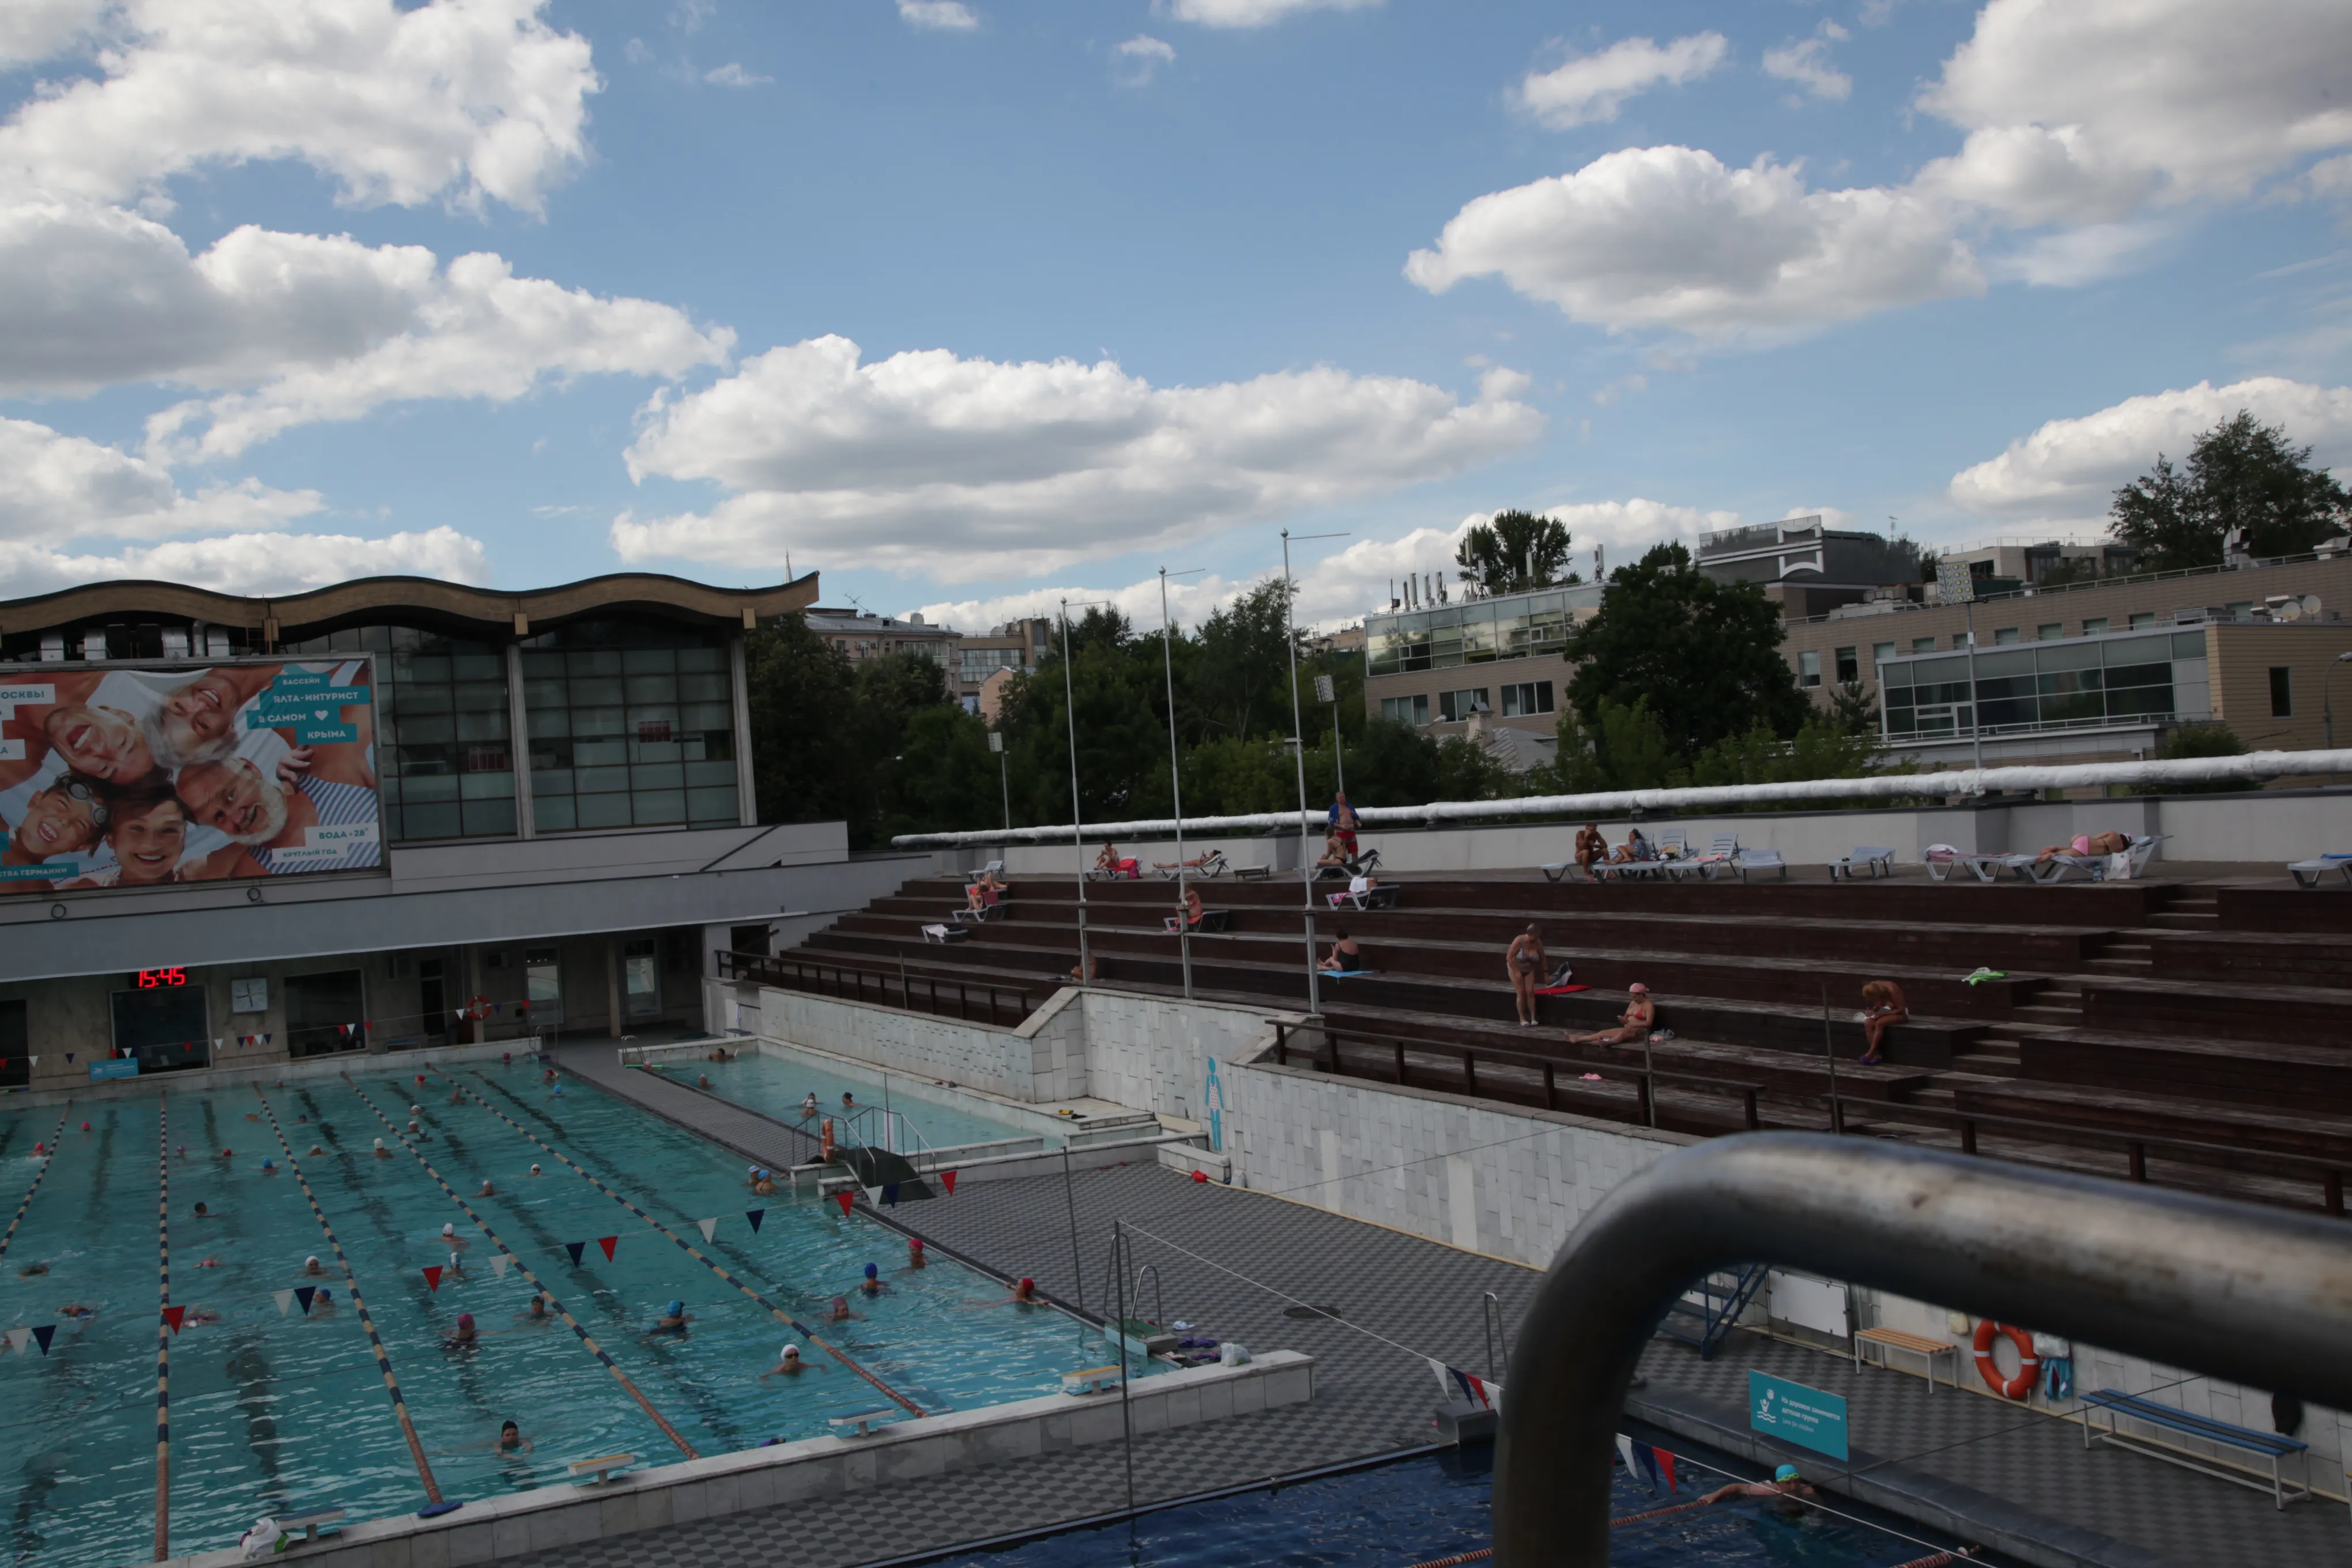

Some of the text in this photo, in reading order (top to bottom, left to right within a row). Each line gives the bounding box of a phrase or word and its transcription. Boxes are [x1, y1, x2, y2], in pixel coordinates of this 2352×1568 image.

[283, 677, 320, 685] БАССЕЙН
[0, 691, 44, 699] ОСКВЫ
[273, 692, 359, 703] ЯЛТА-ИНТУРИСТ
[267, 714, 306, 722] САМОМ
[307, 730, 346, 739] КРЫМА
[319, 831, 347, 839] ВОДА
[283, 848, 320, 858] КРУГЛЫЙ
[21, 867, 67, 876] ГЕРМАНИИ
[138, 966, 186, 988] 15:45
[1781, 1395, 1789, 1404] На
[1801, 1414, 1819, 1424] группа
